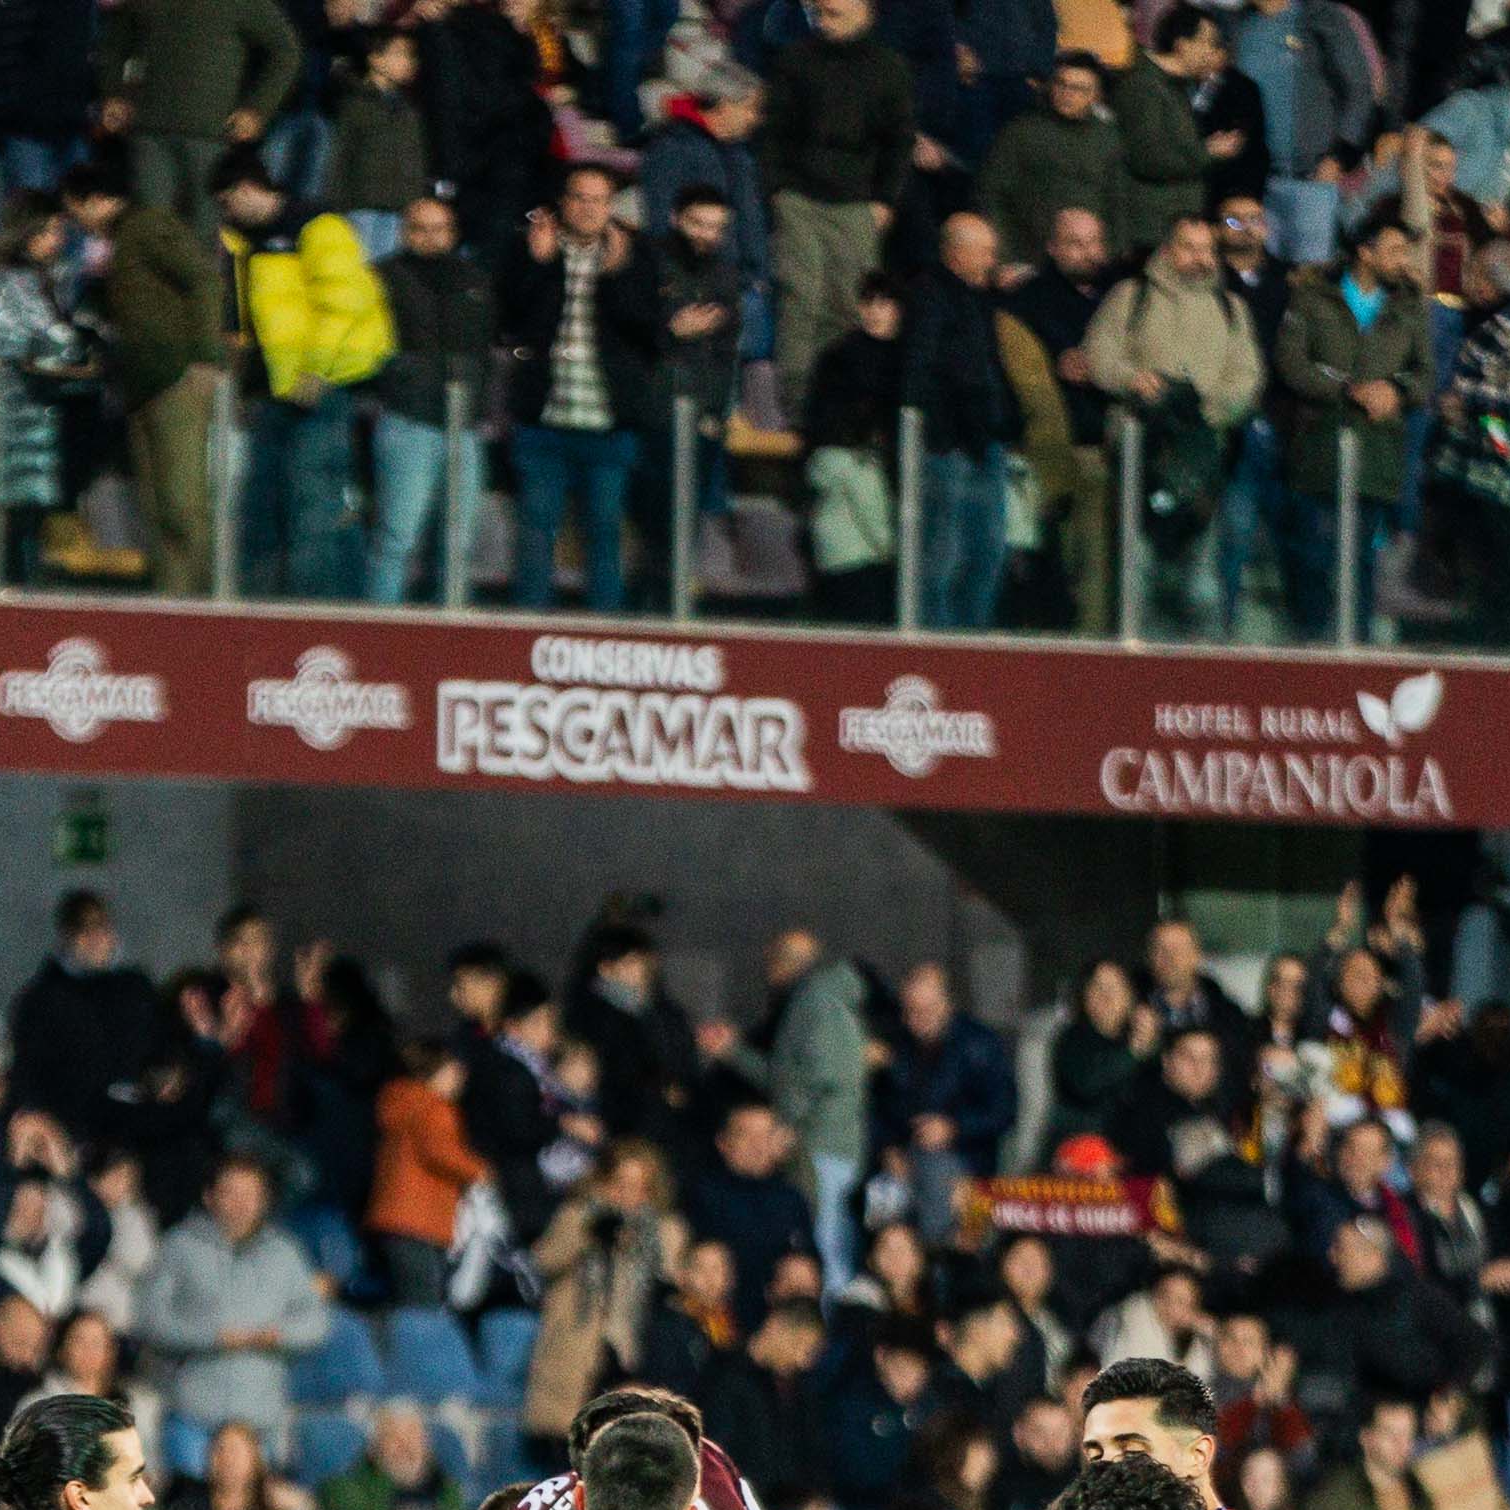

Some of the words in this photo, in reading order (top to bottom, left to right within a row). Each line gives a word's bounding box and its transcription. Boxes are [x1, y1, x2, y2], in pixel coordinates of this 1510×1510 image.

[531, 636, 724, 692] CONSERVAS
[437, 680, 813, 792] PESCAMAR
[1154, 704, 1252, 739] HOTEL
[1260, 707, 1358, 744] RURAL
[1100, 747, 1455, 821] CAMPANIOLA
